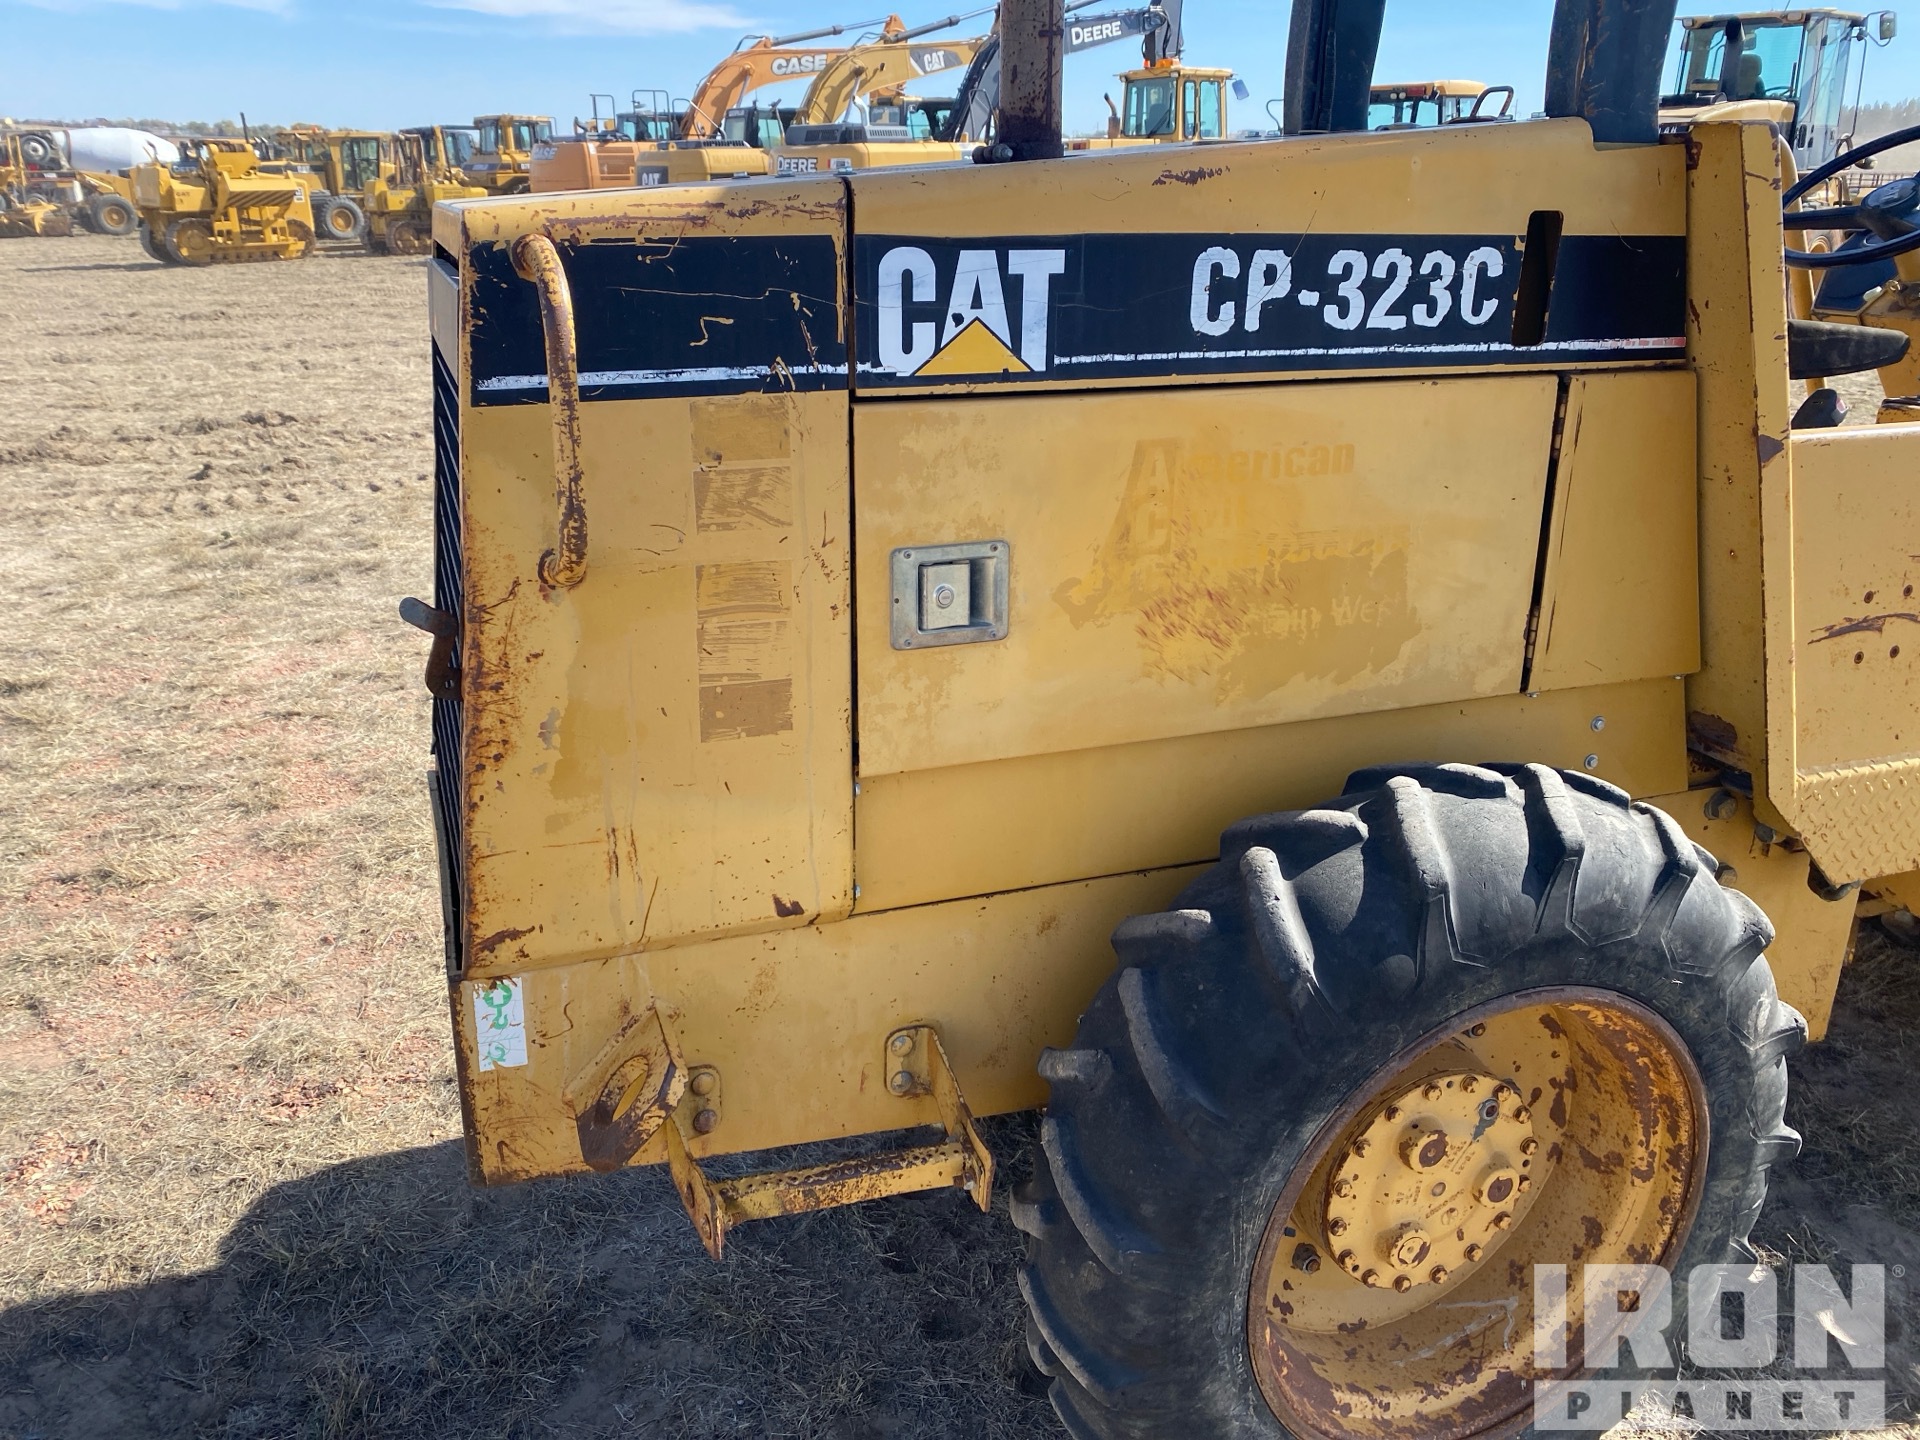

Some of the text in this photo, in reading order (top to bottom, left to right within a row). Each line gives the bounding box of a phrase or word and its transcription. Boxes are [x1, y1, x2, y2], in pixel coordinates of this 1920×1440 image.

[1071, 21, 1122, 45] DEERE
[771, 54, 827, 76] CASE
[923, 50, 946, 71] CAT
[777, 155, 818, 173] DEERE
[641, 172, 661, 186] CAT
[877, 245, 1505, 376] CAT CP-323C
